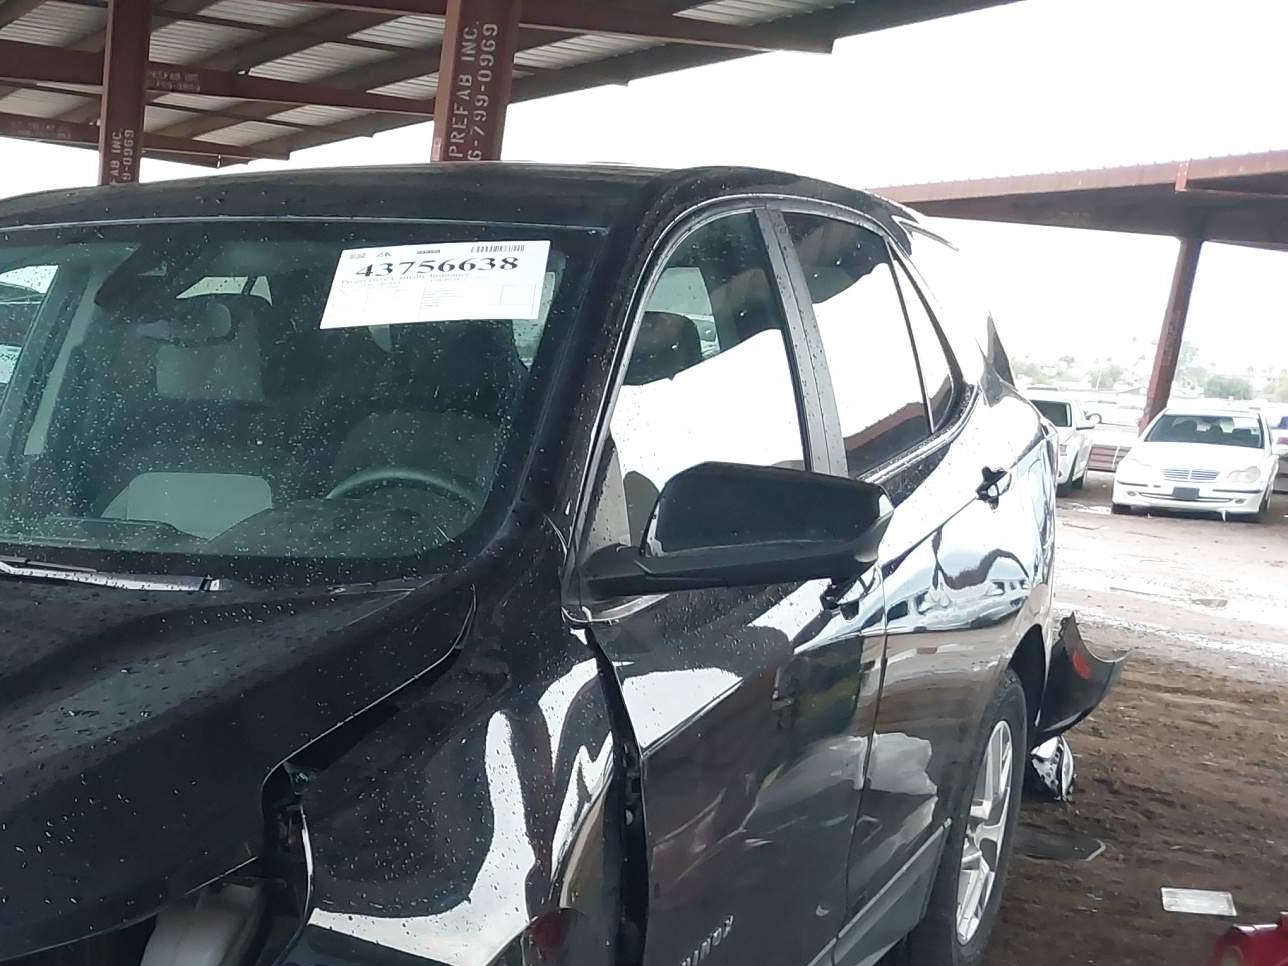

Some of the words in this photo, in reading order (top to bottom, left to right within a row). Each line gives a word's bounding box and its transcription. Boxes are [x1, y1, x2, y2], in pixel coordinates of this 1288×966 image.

[460, 20, 480, 62] INC.
[448, 73, 473, 158] PREFAB
[355, 256, 519, 278] 43756638
